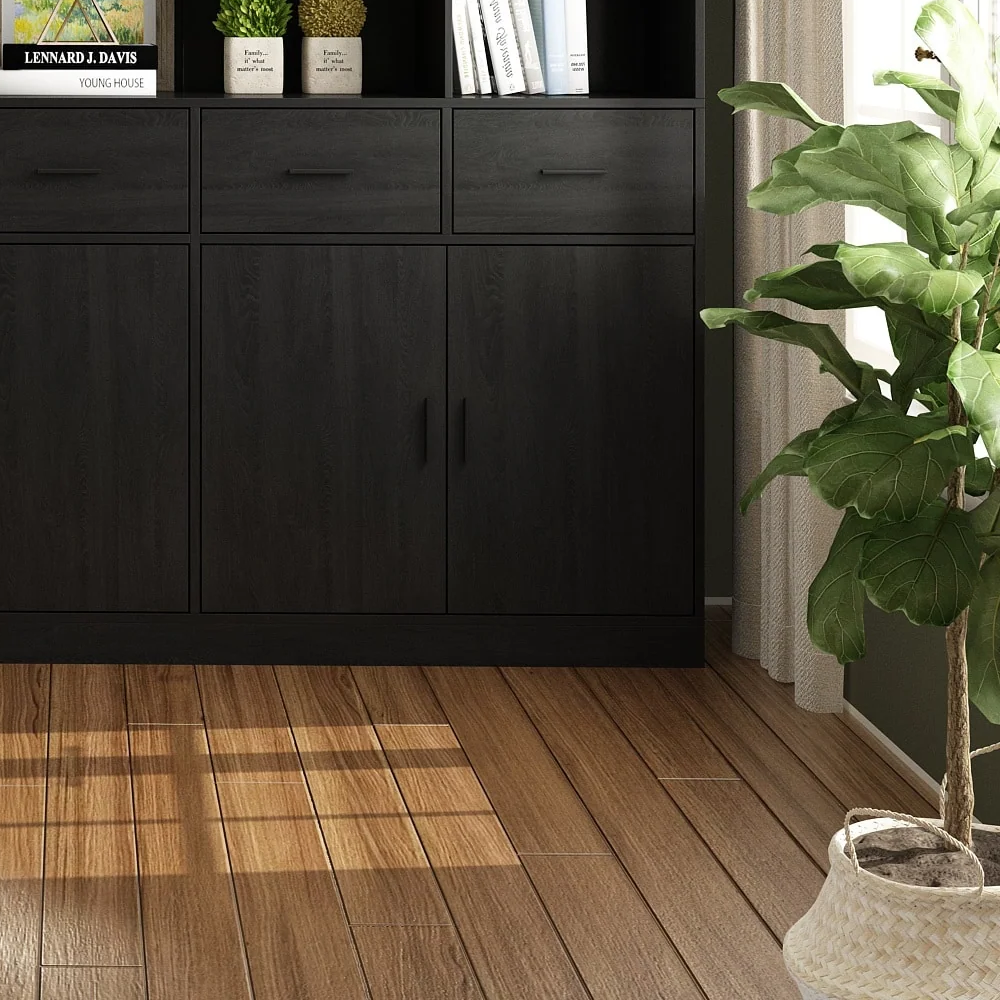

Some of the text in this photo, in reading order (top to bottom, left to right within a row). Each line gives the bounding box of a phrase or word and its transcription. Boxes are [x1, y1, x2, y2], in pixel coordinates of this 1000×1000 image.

[24, 51, 138, 64] LENNARD J. DAVIS
[244, 49, 269, 57] Family...
[323, 49, 348, 57] Family...
[79, 77, 145, 88] YOUNG HOUSE
